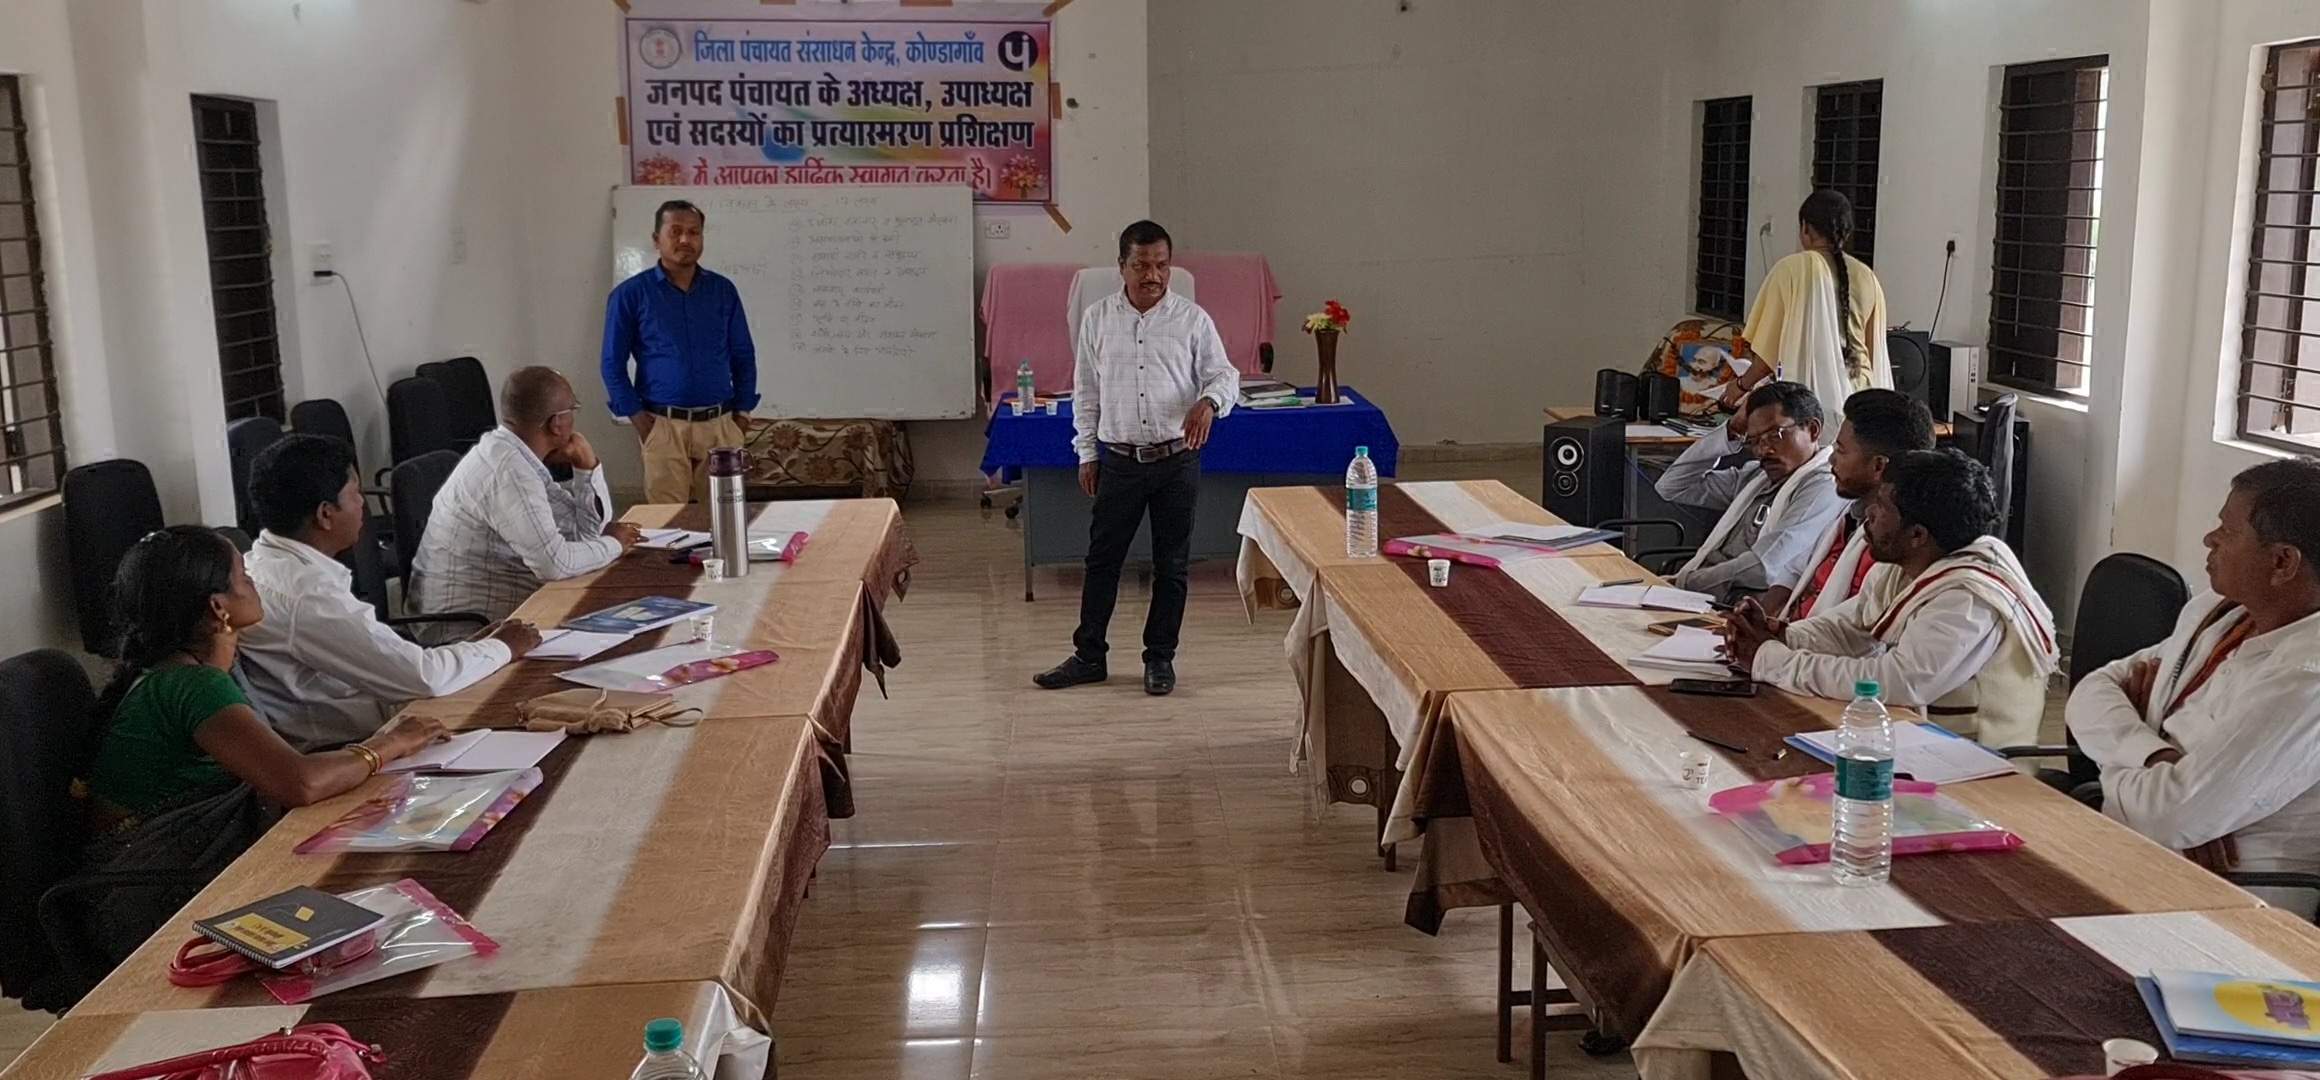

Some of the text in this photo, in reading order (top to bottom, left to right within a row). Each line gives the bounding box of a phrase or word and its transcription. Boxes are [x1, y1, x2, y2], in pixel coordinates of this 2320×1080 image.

[694, 29, 985, 66] जिला पंचायत संसाधन केन्द्र, कोण्डागाँव
[645, 72, 1034, 112] जनपद पंचायत के अध्यक्ष, उपाध्यक्ष
[646, 113, 682, 146] एवं
[689, 113, 768, 147] सदस्यों
[772, 120, 805, 147] का
[938, 113, 1035, 148] प्रशिक्षण
